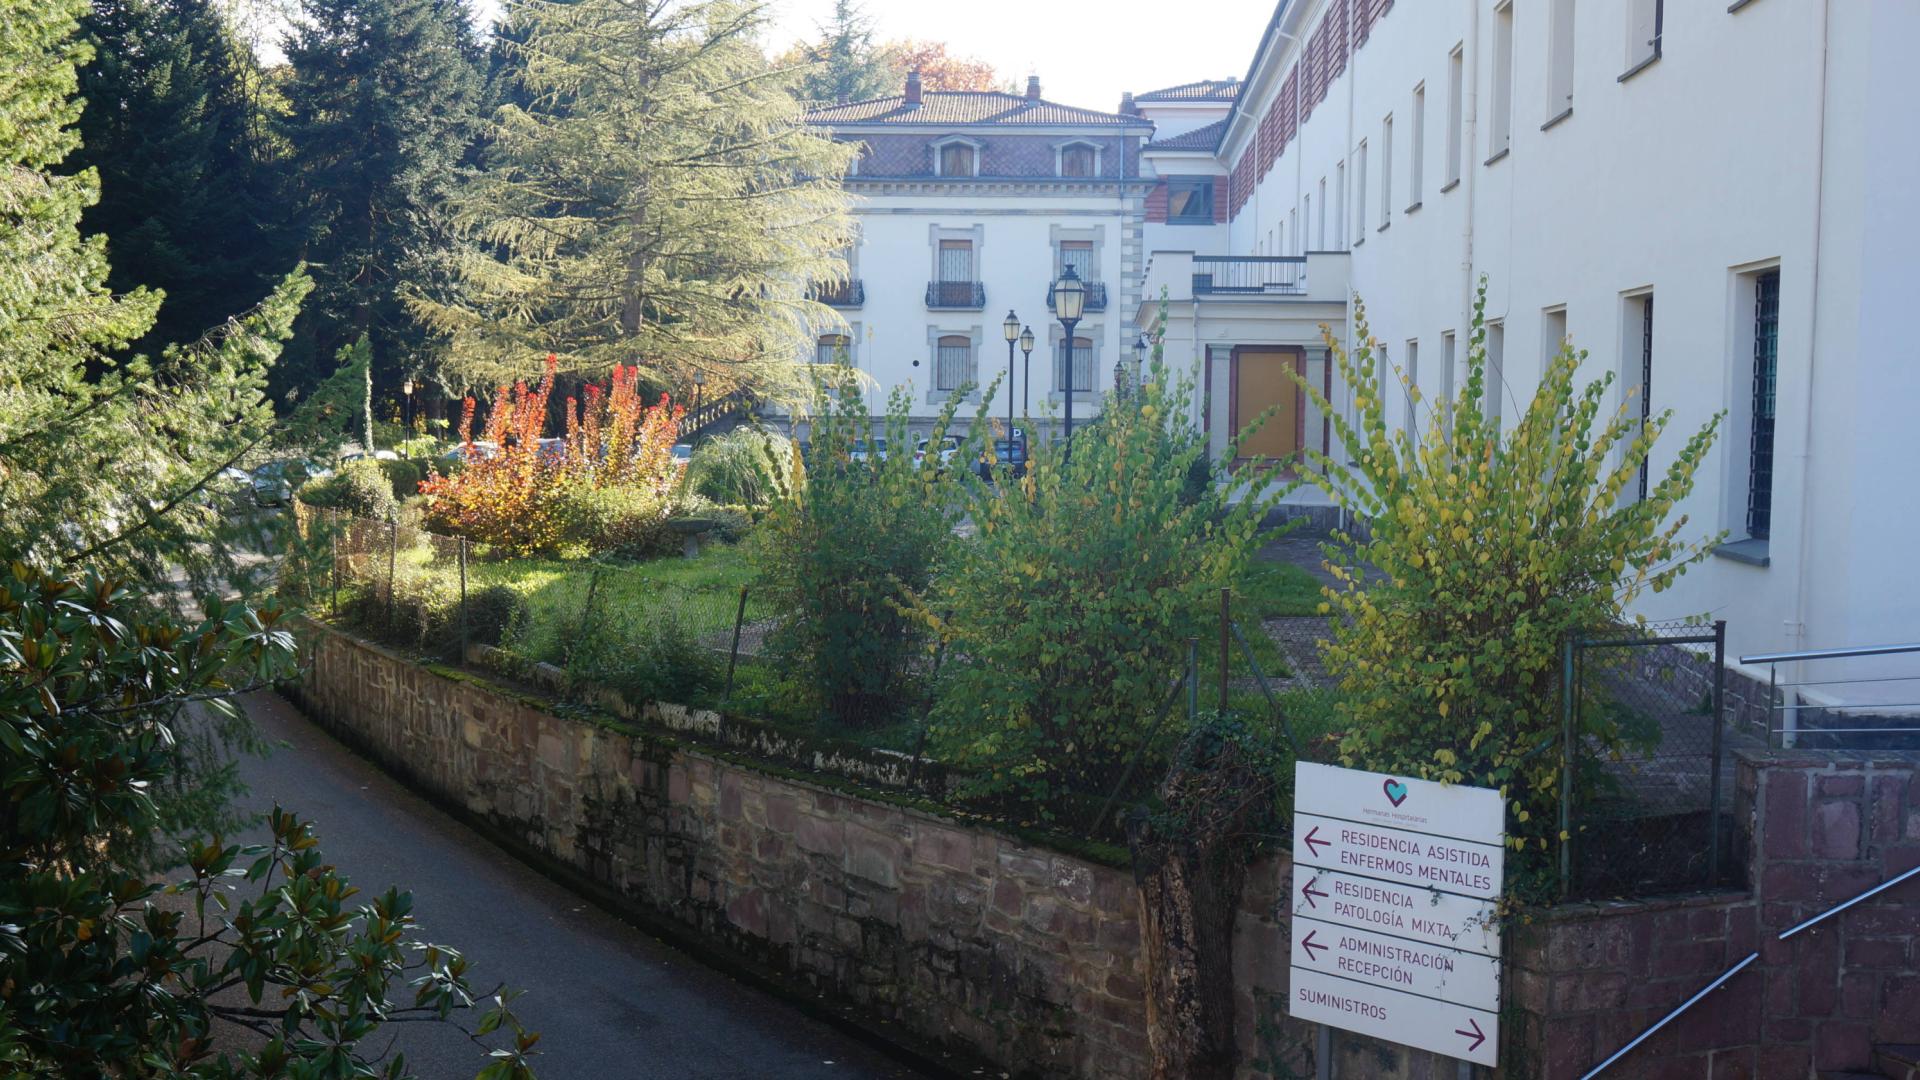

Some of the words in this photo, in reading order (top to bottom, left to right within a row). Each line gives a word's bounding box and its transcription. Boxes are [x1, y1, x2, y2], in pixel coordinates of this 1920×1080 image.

[1341, 829, 1421, 856] RESIDENCIA
[1427, 845, 1491, 869] ASISTIDA
[1340, 850, 1413, 876] ENFERMOS
[1418, 865, 1491, 891] MENTALES
[1335, 880, 1414, 909] RESIDENCIA
[1334, 902, 1404, 929] PATOLOGÍA
[1411, 918, 1452, 939] MIXTA
[1338, 956, 1413, 985] RECEPCIÓN
[1339, 936, 1455, 973] ADMINISTRACIÓN
[1299, 988, 1387, 1021] SUMINISTROS
